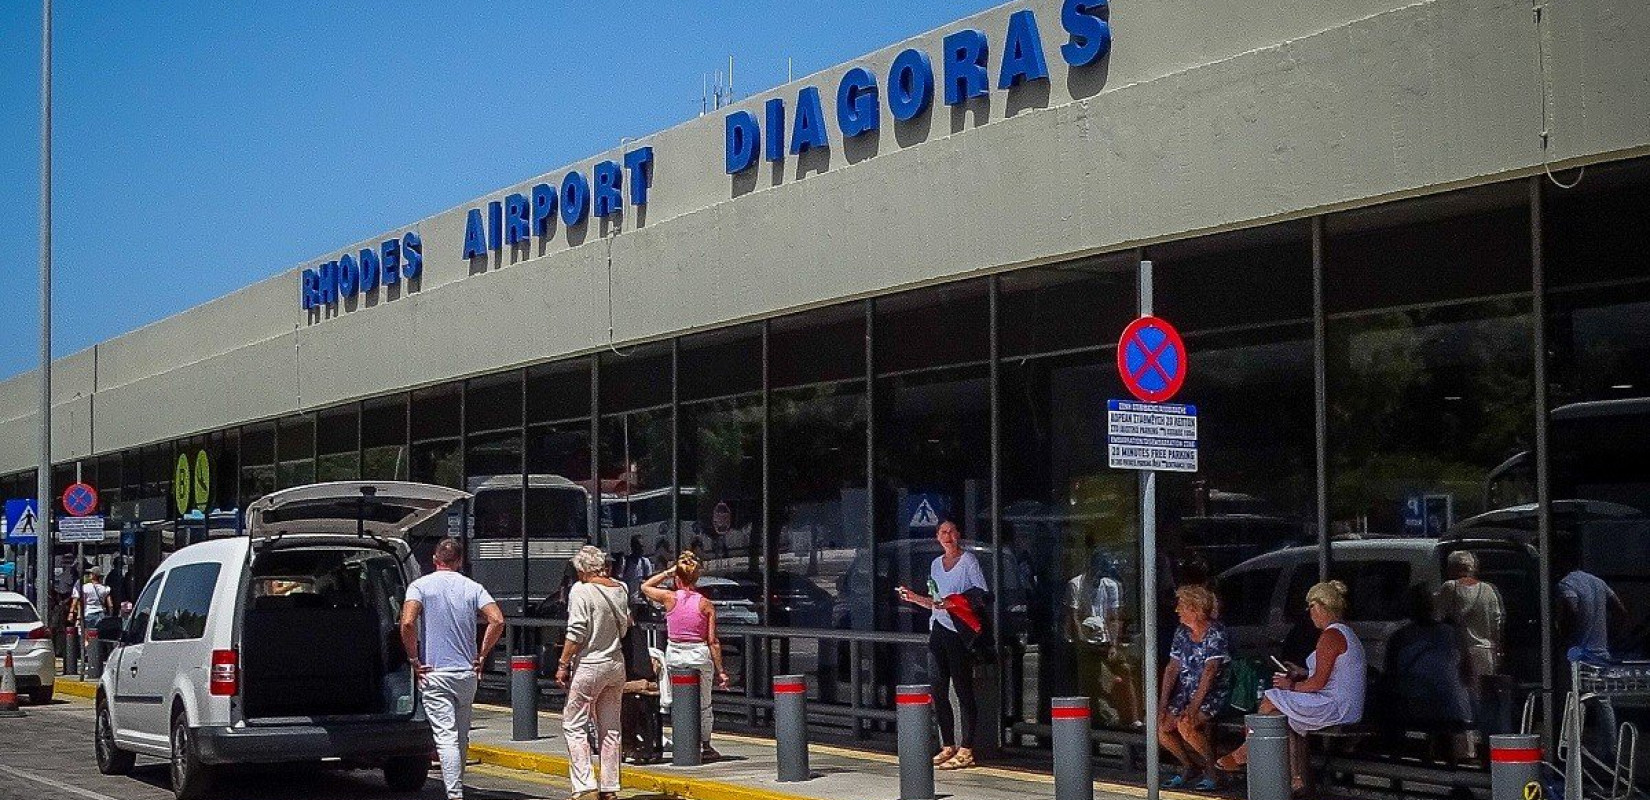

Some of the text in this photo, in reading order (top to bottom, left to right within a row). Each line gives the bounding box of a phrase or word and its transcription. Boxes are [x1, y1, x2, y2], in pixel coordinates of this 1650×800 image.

[302, 0, 1111, 310] RHODES AIRPORT DIAGORAS
[1151, 449, 1166, 458] FREE
